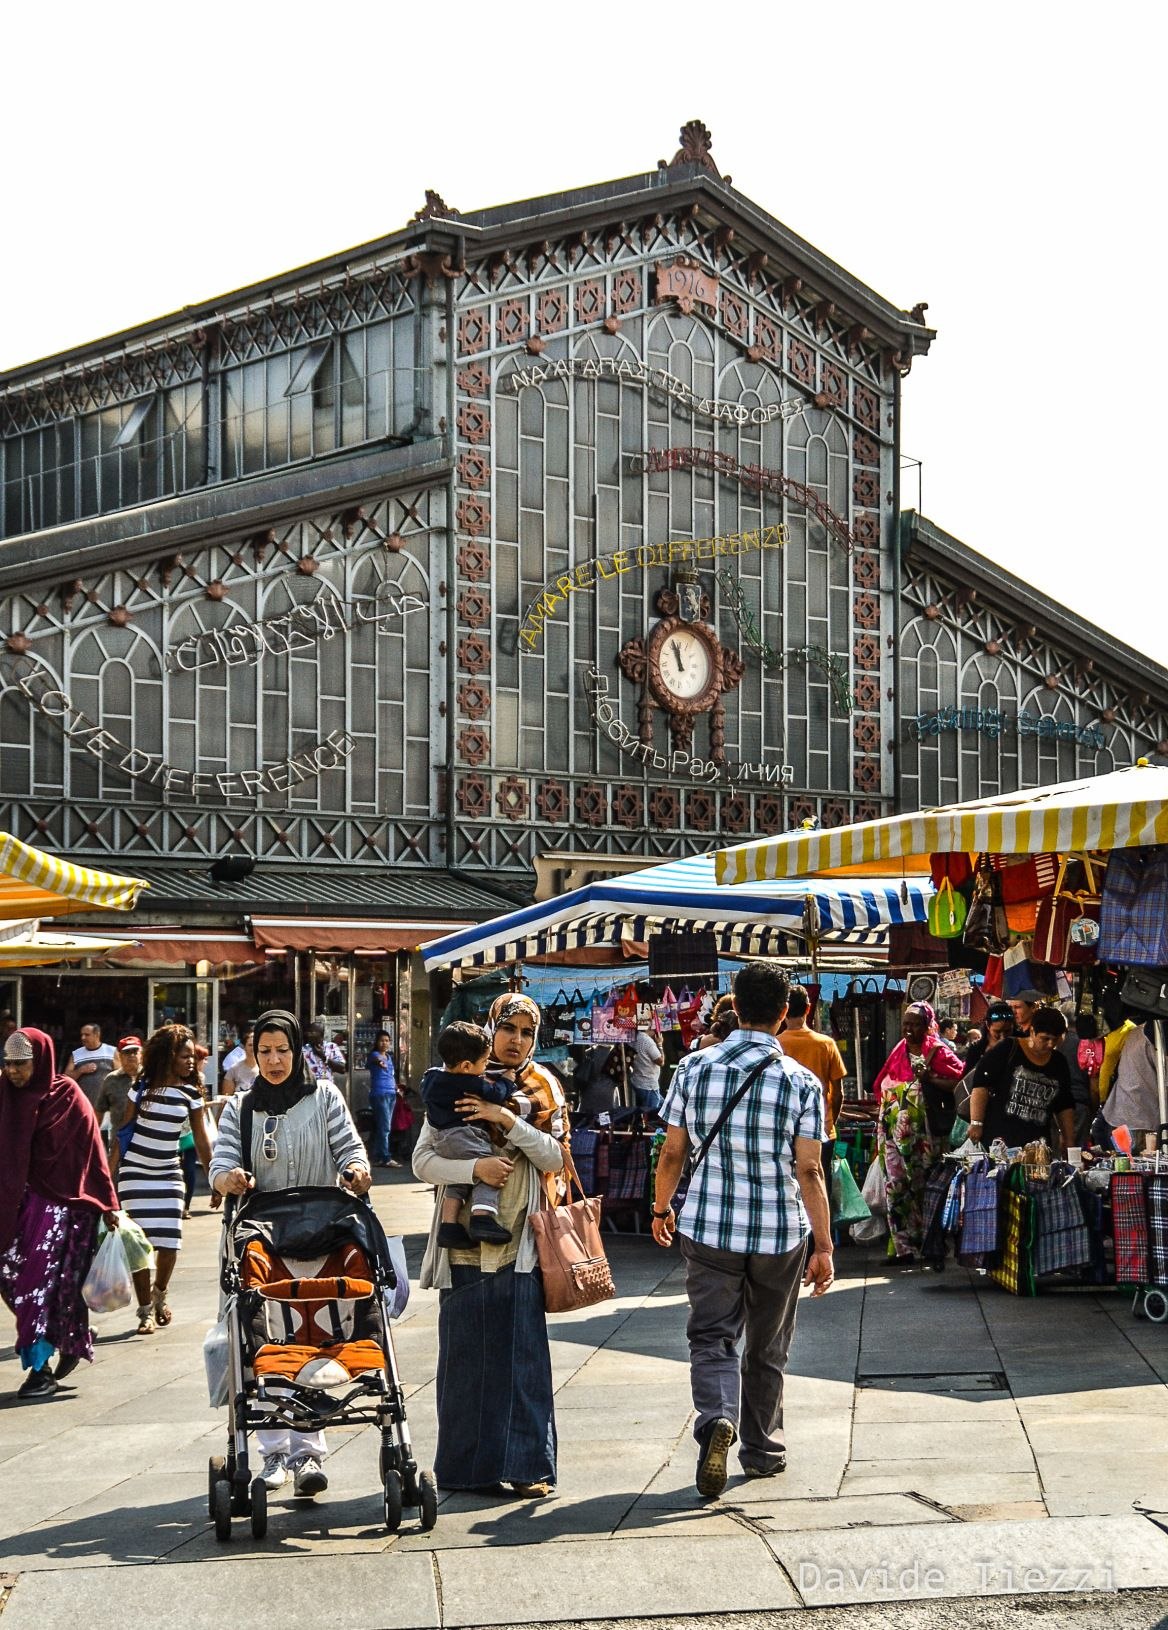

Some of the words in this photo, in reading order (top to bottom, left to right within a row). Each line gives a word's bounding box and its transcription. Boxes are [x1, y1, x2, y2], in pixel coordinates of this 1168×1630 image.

[668, 270, 705, 297] 1916
[519, 564, 597, 650] AMARE
[596, 551, 631, 579] LE
[637, 523, 792, 567] DIFFERENZE
[18, 670, 120, 759] LOVE
[118, 729, 357, 797] DIFFERENCE
